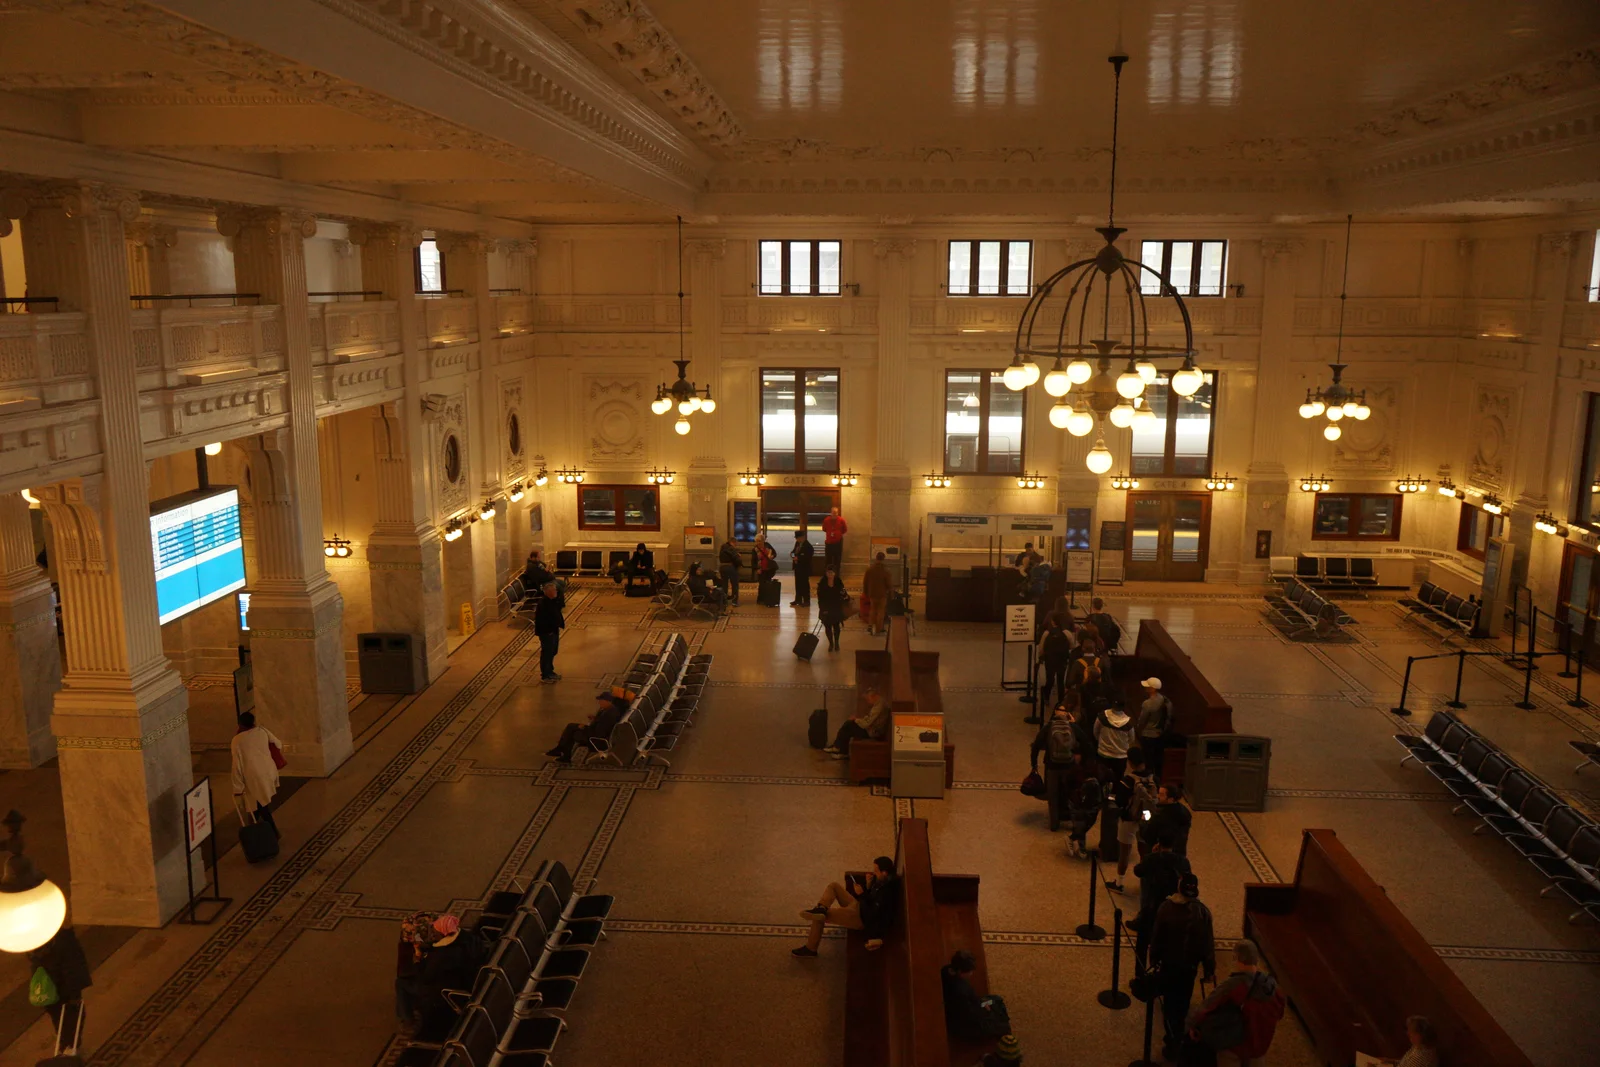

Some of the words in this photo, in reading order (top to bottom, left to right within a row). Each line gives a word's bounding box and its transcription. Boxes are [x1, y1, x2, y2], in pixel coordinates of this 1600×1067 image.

[783, 475, 808, 485] GATE
[1153, 480, 1178, 489] GATE
[896, 726, 901, 734] 2
[898, 734, 904, 743] 2
